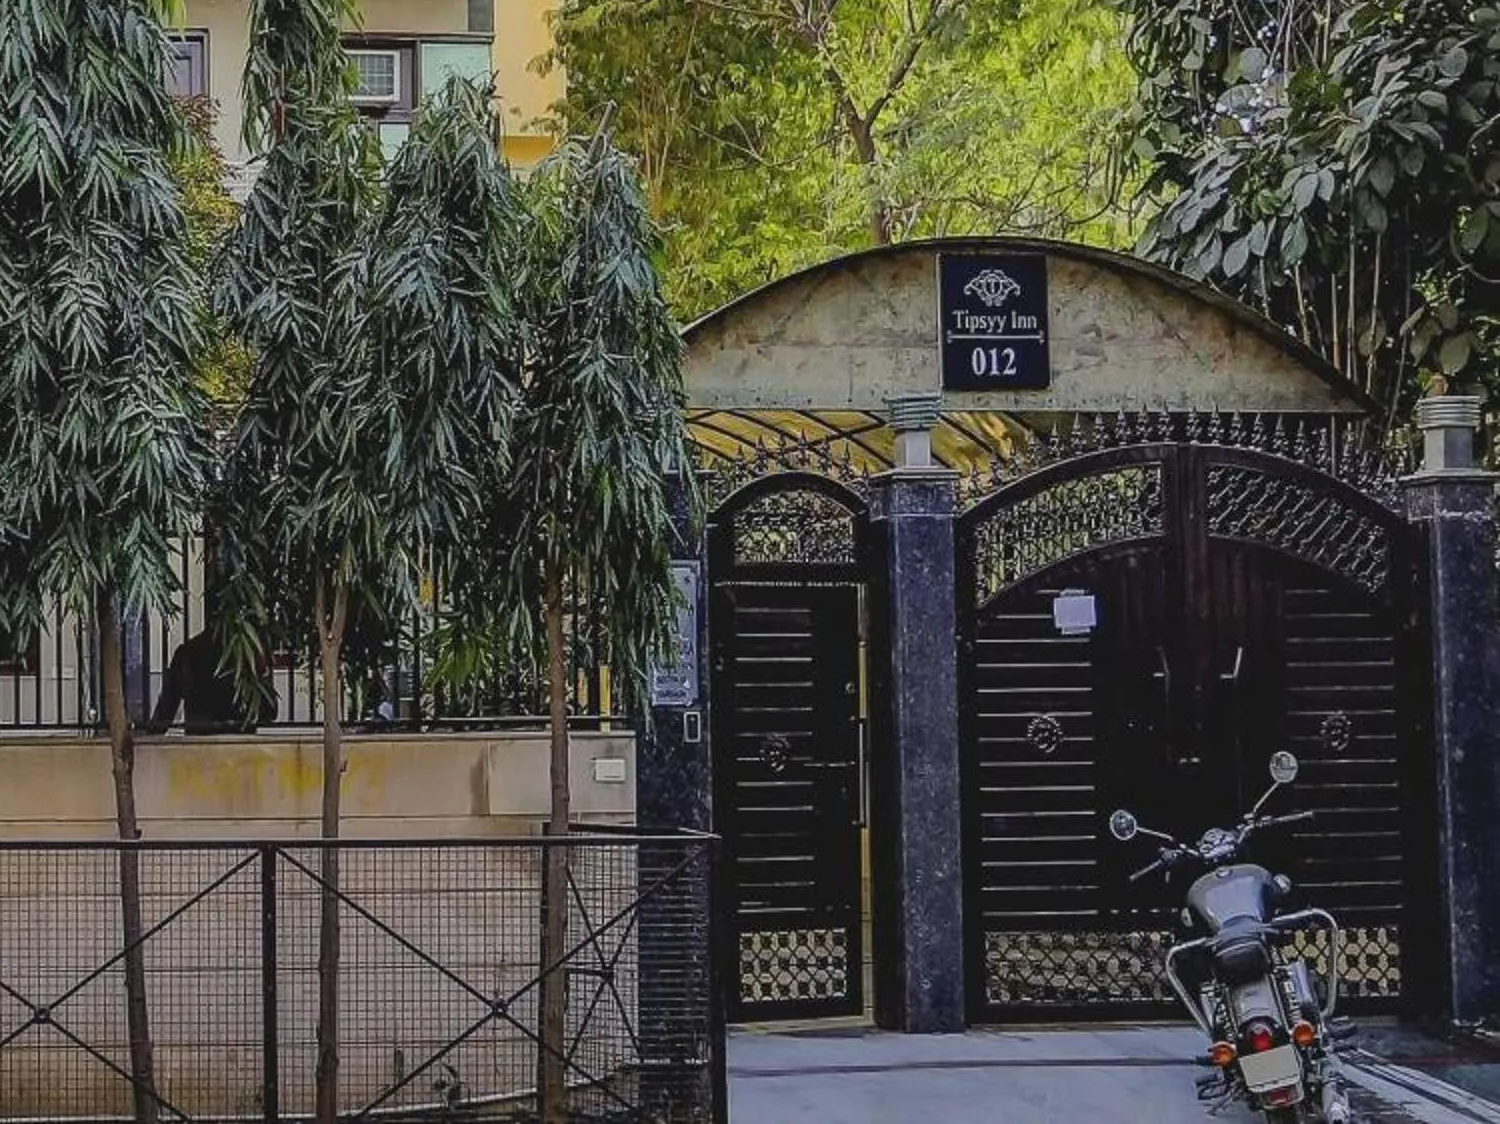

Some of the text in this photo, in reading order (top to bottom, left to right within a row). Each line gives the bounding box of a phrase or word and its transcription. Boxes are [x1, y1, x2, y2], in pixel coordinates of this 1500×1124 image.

[952, 309, 1037, 333] Tipsyy Inn
[971, 347, 1017, 376] 012
